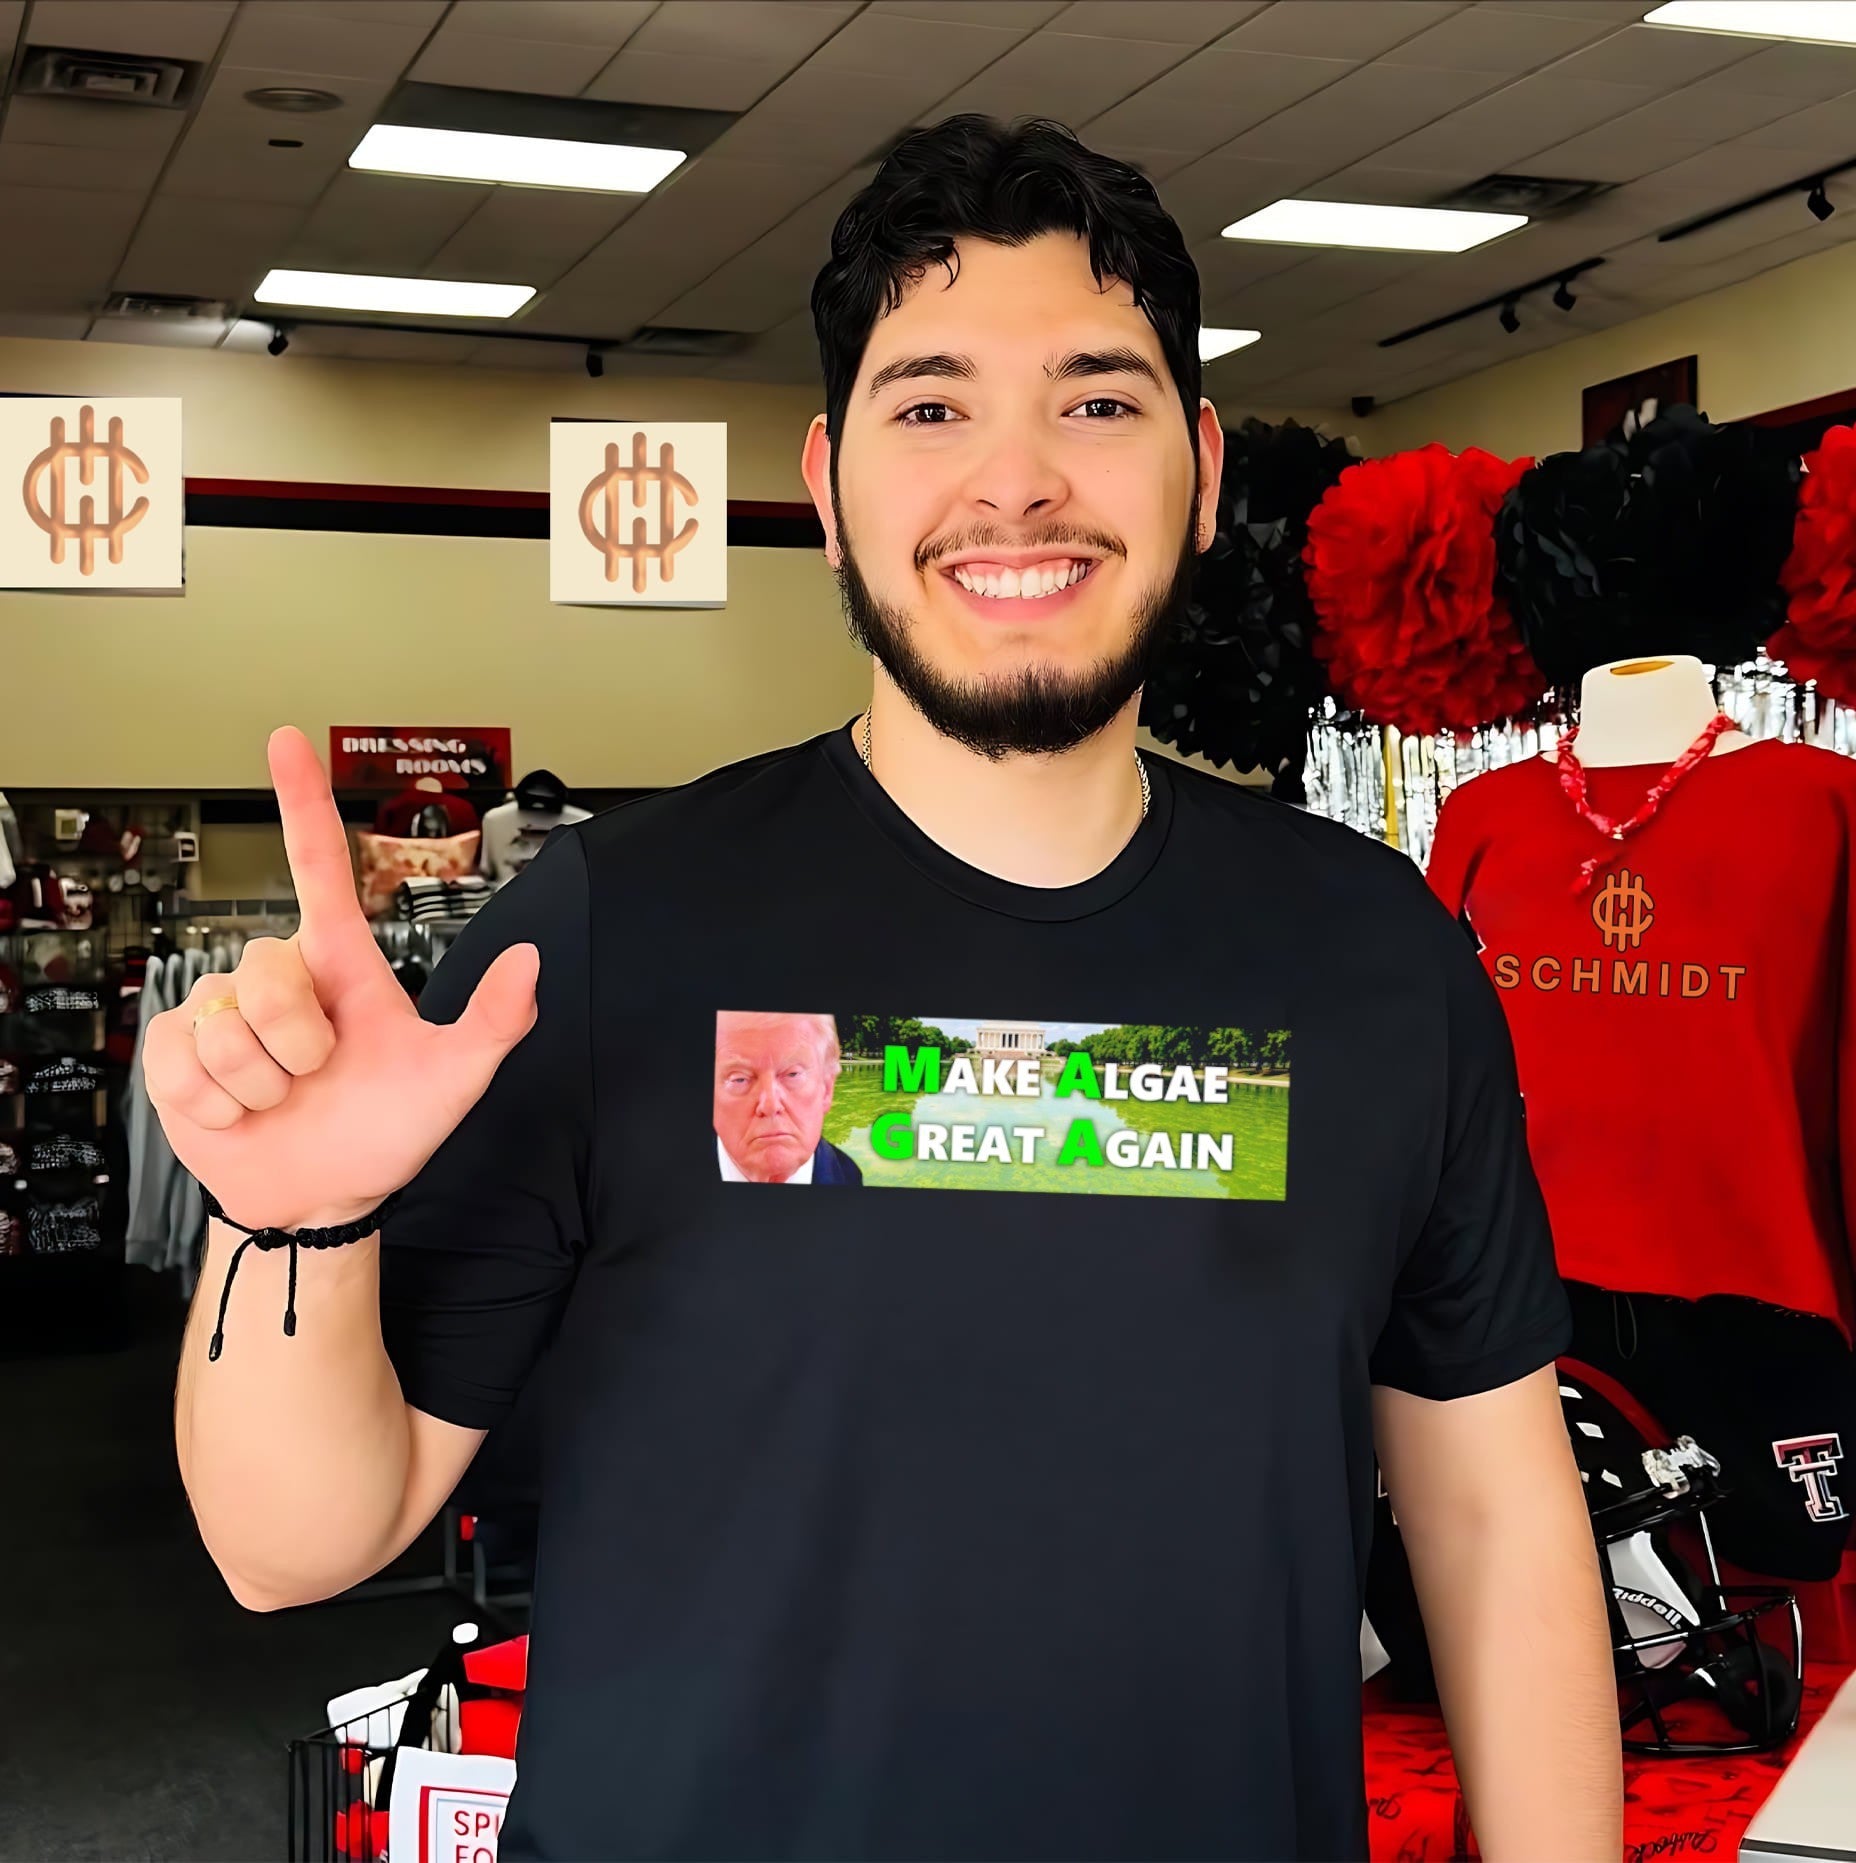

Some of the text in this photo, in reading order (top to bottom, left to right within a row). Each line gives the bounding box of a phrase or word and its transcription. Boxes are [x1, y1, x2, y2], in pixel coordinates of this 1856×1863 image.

[1494, 954, 1746, 1000] SCHMIDT
[883, 1045, 1229, 1103] MAKE ALGAE
[870, 1111, 1234, 1171] GREAT AGAIN
